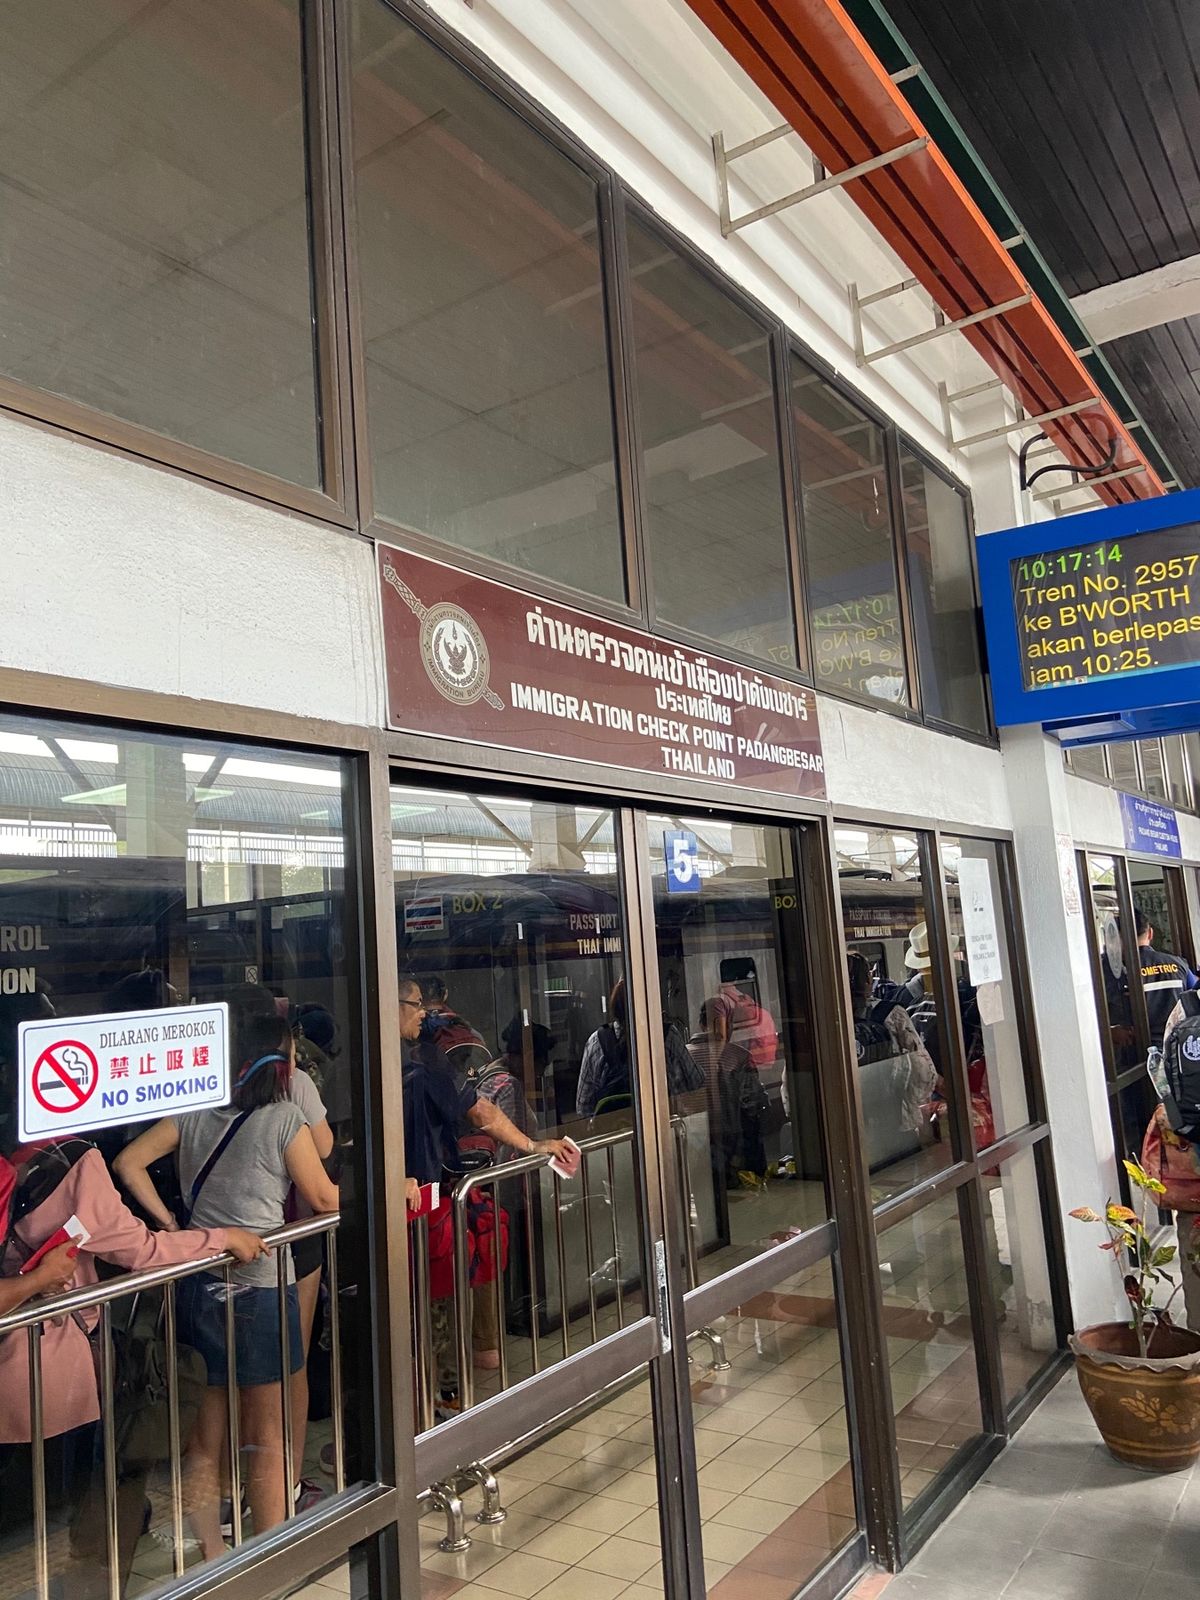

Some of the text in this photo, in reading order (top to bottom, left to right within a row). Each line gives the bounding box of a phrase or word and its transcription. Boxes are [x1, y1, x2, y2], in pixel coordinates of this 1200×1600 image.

[1020, 543, 1122, 581] 10:17:14
[1020, 554, 1200, 606] Tren No. 2957
[1024, 584, 1190, 633] ke B'WORTH
[1027, 634, 1085, 659] akan
[1030, 647, 1159, 686] jam 10:25.
[654, 683, 732, 726] ประเทศไทย
[510, 682, 825, 774] IMMIGRATION CHECK POINT PADANGBESAR
[660, 745, 736, 780] THAILAND
[673, 839, 693, 883] 5
[453, 893, 503, 914] BOX 2
[577, 938, 600, 955] THAI
[0, 967, 36, 995] ON
[99, 1020, 215, 1049] DILARANG MEROKOK
[110, 1045, 209, 1079] 禁止吸煙
[101, 1075, 218, 1109] NO SMOKING
